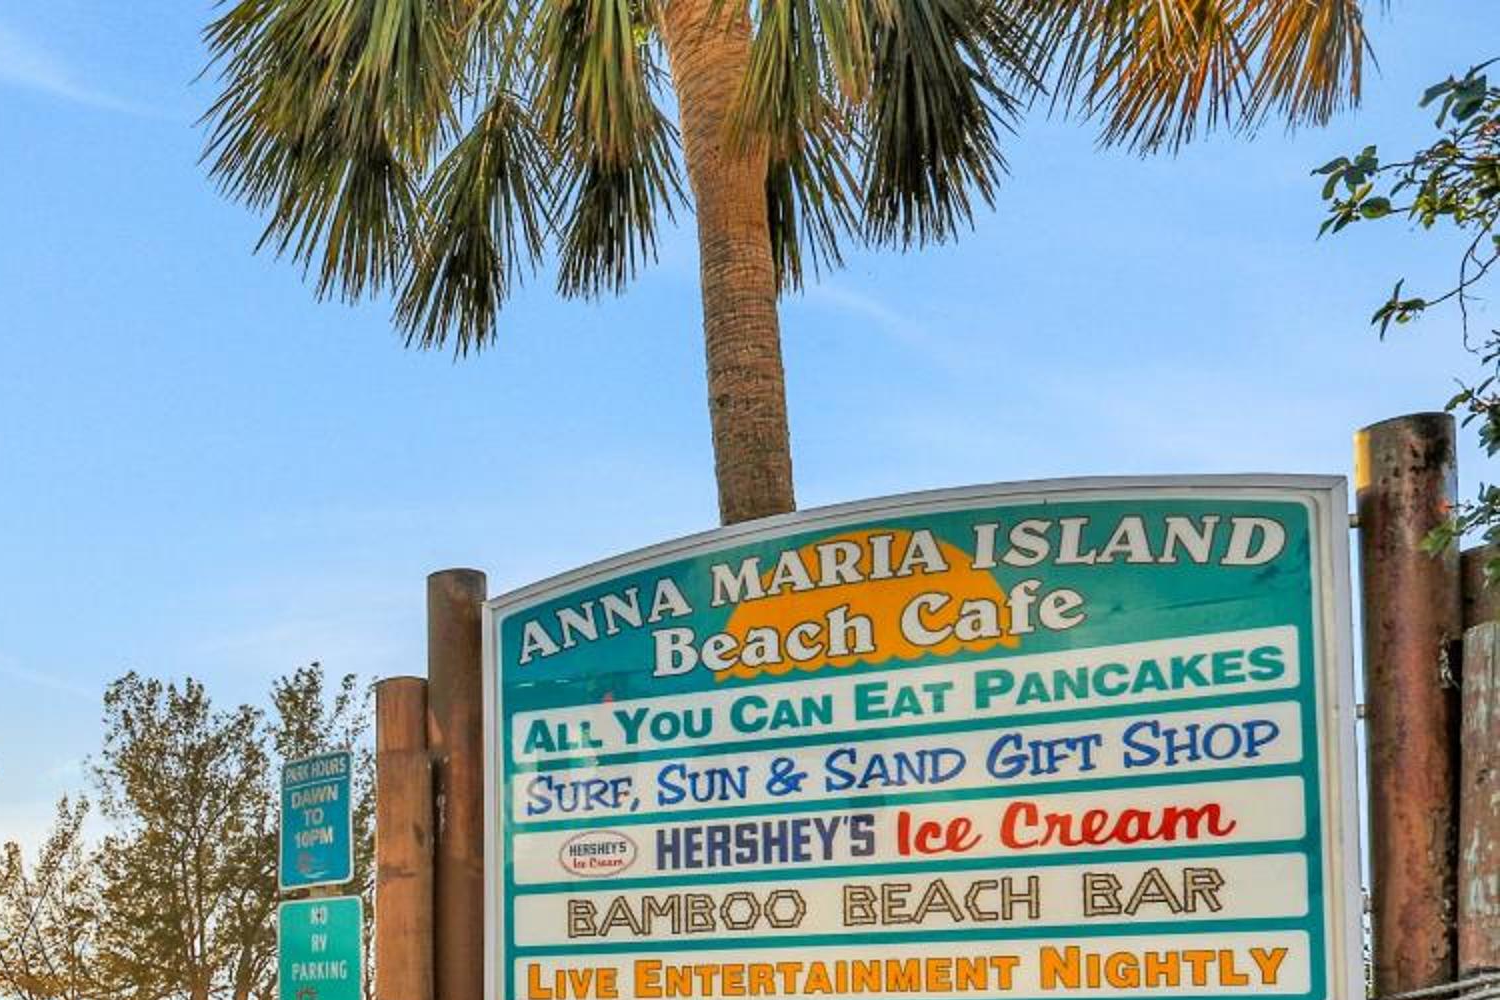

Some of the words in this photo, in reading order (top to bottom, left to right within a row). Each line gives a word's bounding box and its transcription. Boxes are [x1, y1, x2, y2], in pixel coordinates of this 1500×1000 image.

[518, 577, 692, 665] ANNA
[710, 529, 948, 607] MARIA
[971, 515, 1287, 569] ISLAND
[652, 605, 876, 678] Beach
[900, 579, 1087, 646] Cafe
[524, 719, 602, 754] ALL
[614, 707, 712, 745] YOU
[730, 695, 833, 733] CAN
[855, 682, 953, 721] EAT
[975, 645, 1285, 709] PANCAKES
[311, 756, 347, 777] HOURS
[526, 775, 640, 816] SURF,
[658, 763, 748, 805] SUN
[766, 757, 806, 796] &
[825, 748, 966, 791] SAND
[987, 733, 1102, 779] GIFT
[1123, 720, 1280, 769] SHOP
[291, 783, 338, 809] DAWN
[304, 807, 324, 826] TO
[294, 826, 333, 849] 10PM
[656, 813, 875, 871] HERSHEY'S
[898, 810, 983, 856] Ice
[1000, 801, 1237, 849] Cream
[567, 889, 806, 938] BAMBOO
[843, 875, 1040, 926] BEACH
[1083, 867, 1225, 917] BAR
[291, 959, 347, 981] PARKING
[311, 933, 327, 953] RV
[527, 963, 618, 1000] LIVE
[634, 955, 1020, 998] ENTERTAINMENT
[1039, 946, 1289, 990] NIGHTLY
